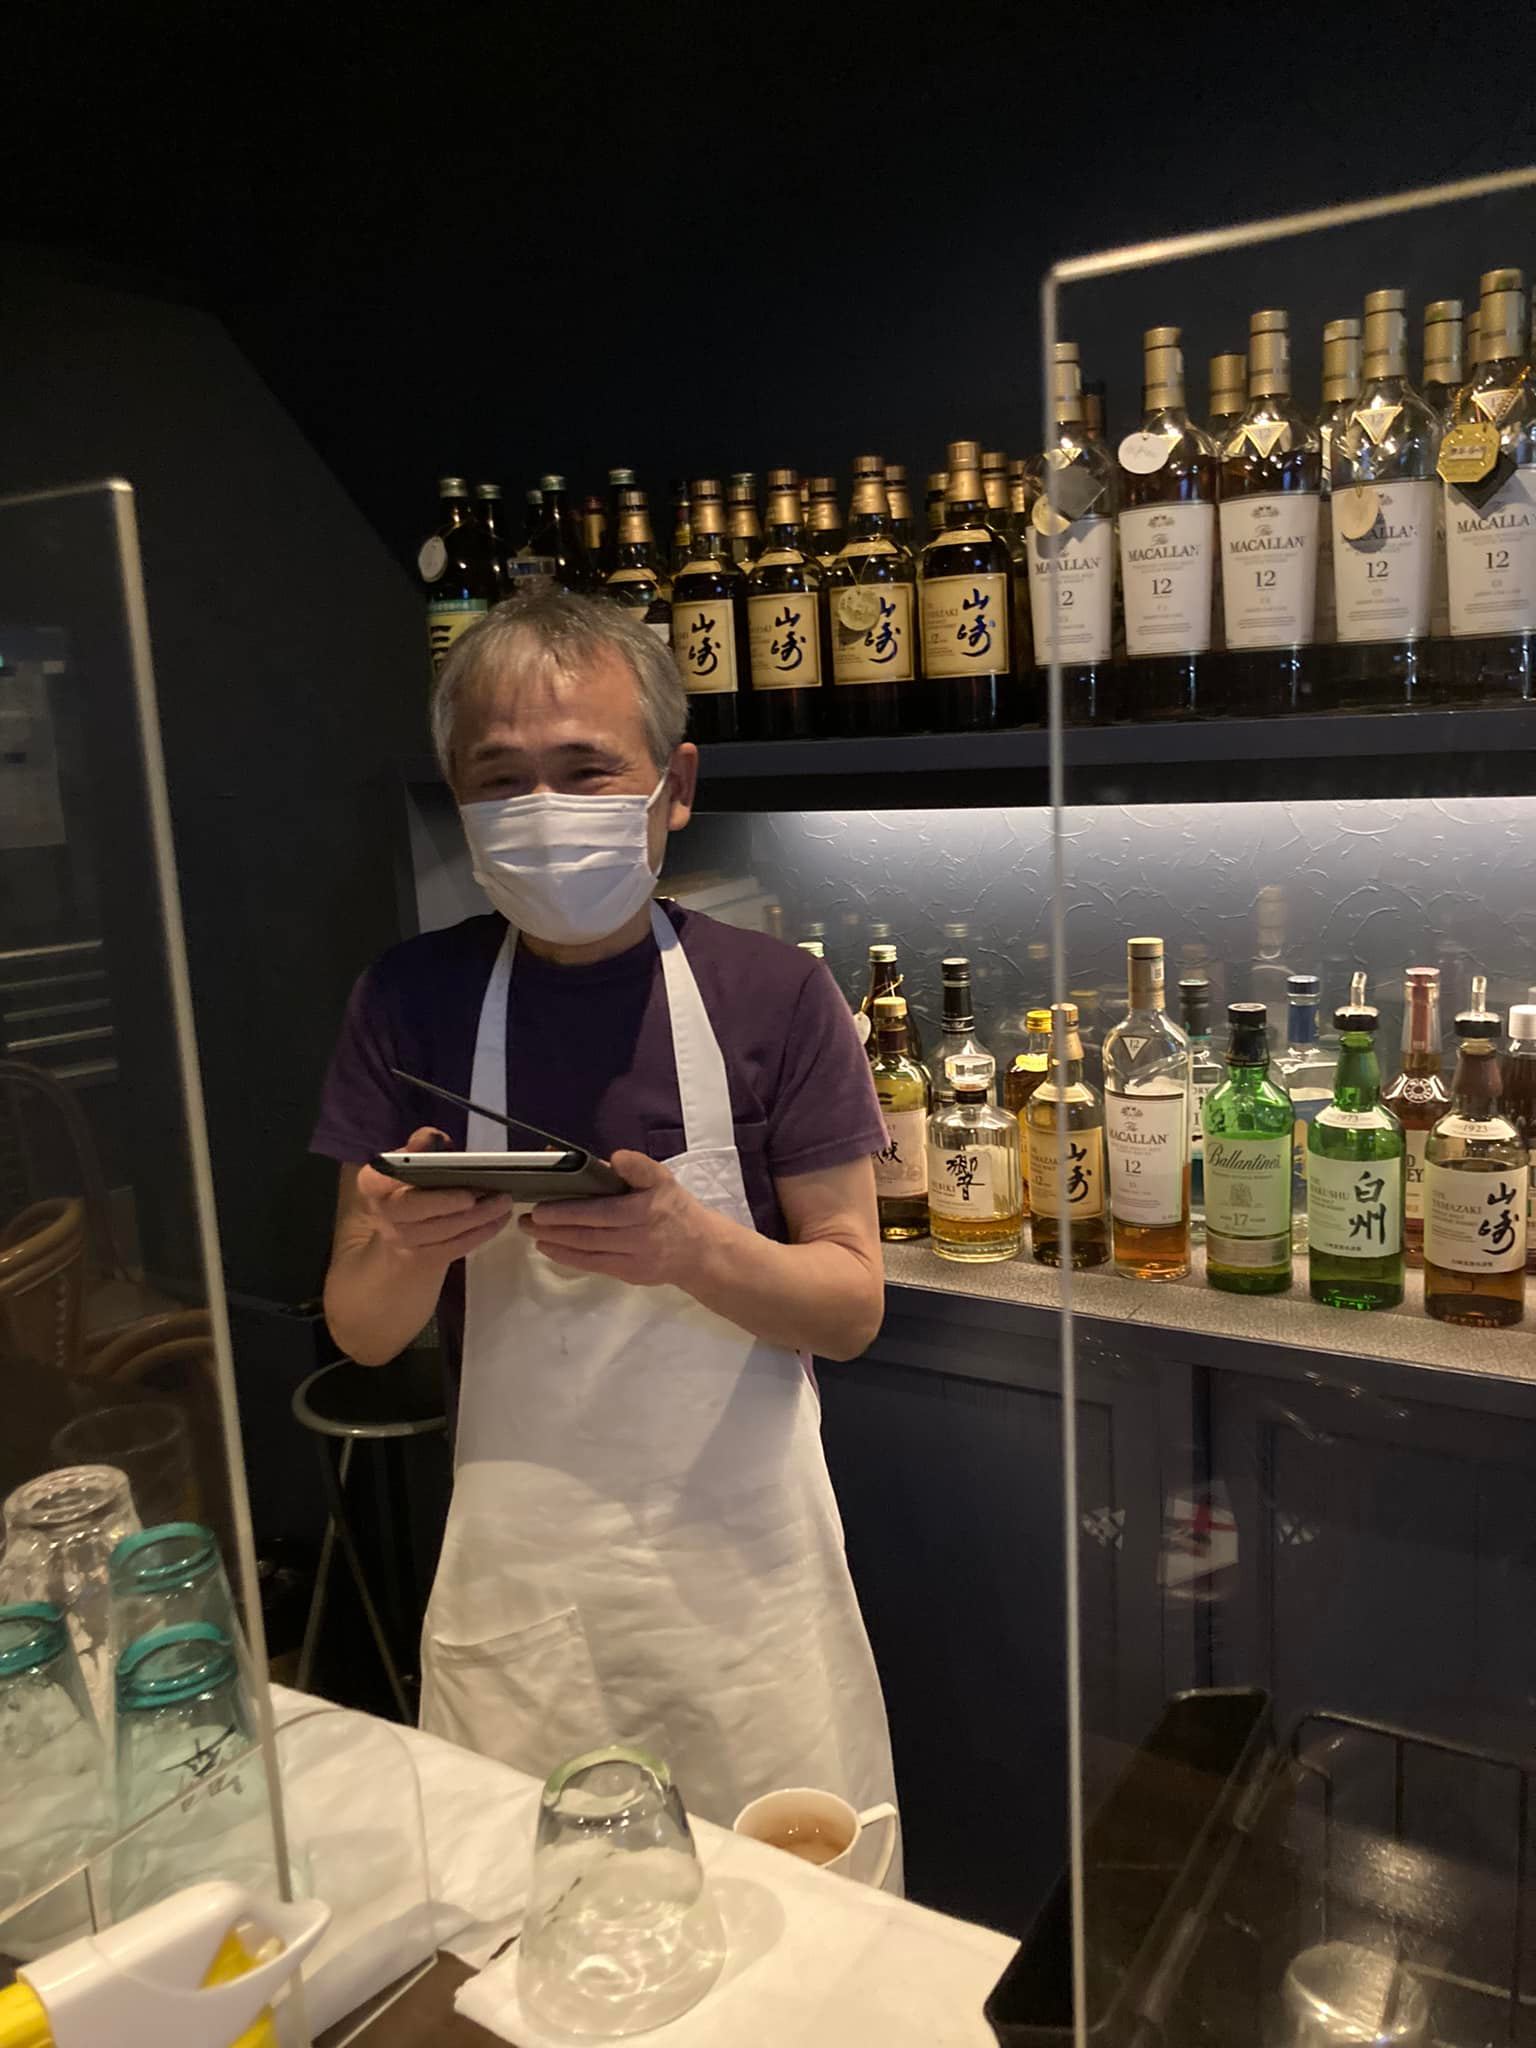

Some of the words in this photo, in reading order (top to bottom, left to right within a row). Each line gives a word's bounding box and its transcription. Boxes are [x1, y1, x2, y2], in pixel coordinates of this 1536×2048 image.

[1128, 544, 1200, 563] MACALLAN
[1229, 536, 1306, 554] MACALLAN
[1035, 557, 1101, 576] MAALLAN
[1366, 560, 1390, 579] 12
[1485, 550, 1510, 570] 12
[1152, 578, 1172, 596] 12
[1255, 570, 1277, 588] 12
[957, 588, 996, 657] 山崎
[688, 613, 722, 676] 山崎
[770, 606, 807, 671] 山崎
[1124, 1159, 1142, 1175] 12
[1349, 1170, 1387, 1245] 白州
[1233, 1213, 1249, 1227] 17
[1478, 1182, 1520, 1256] 山崎
